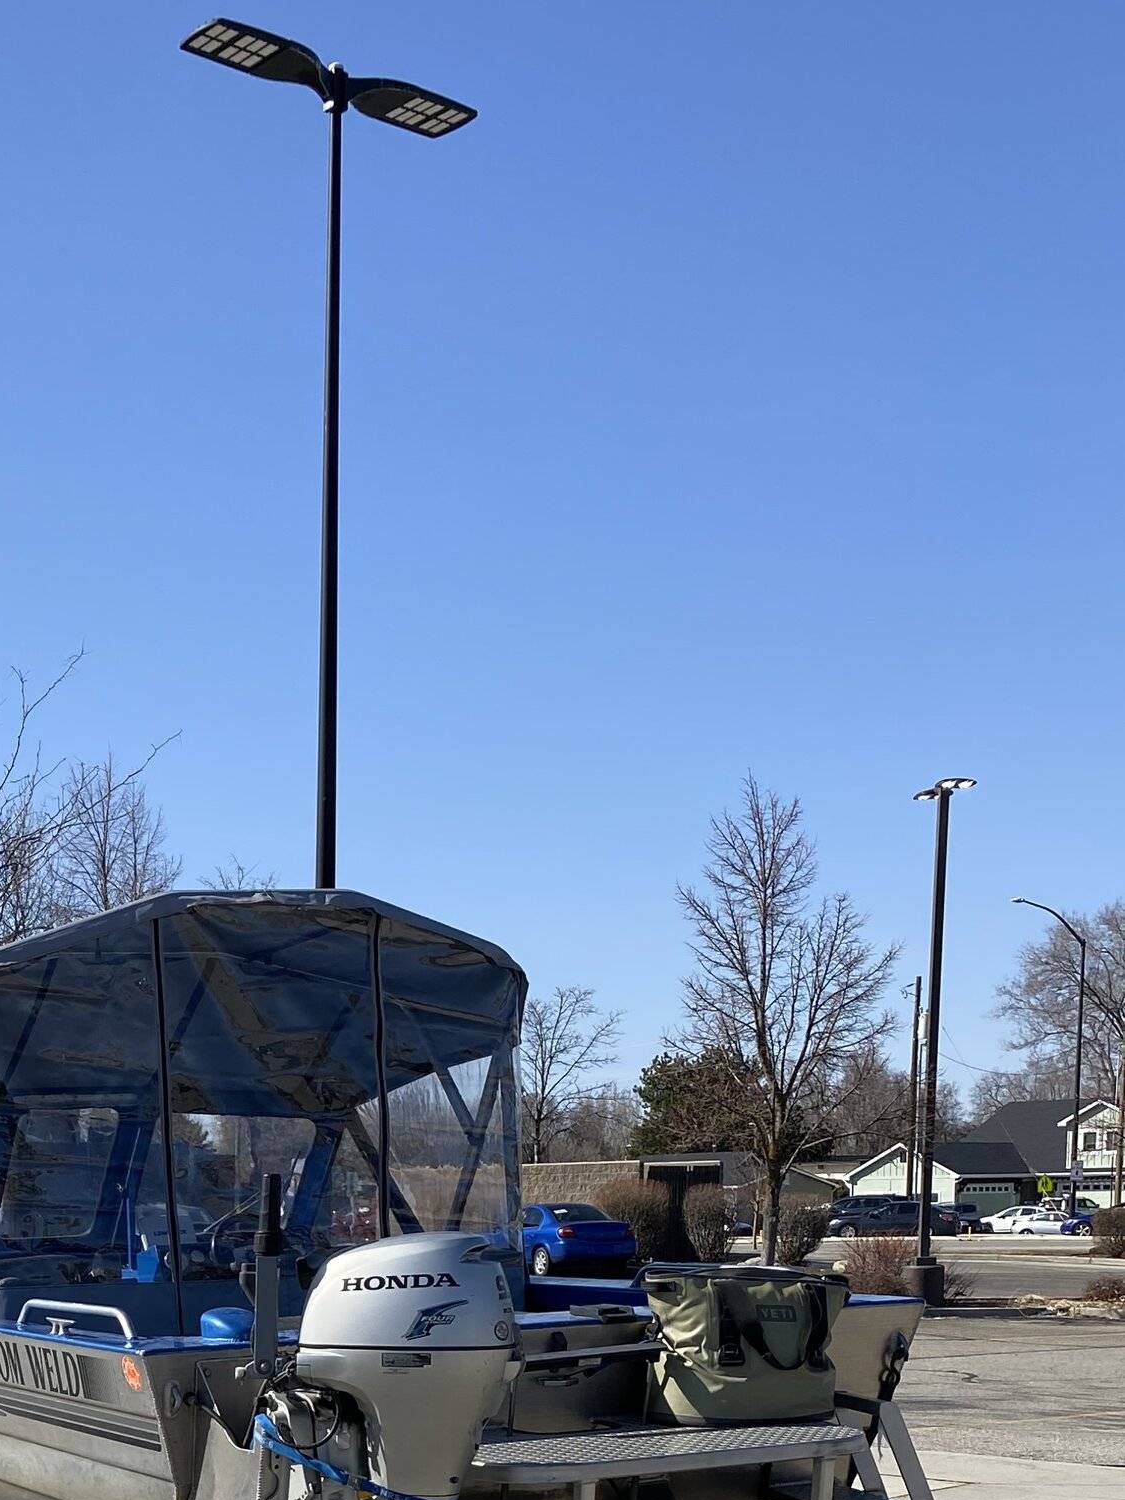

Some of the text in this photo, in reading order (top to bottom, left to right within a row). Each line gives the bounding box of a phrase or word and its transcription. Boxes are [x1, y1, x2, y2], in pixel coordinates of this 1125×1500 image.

[341, 1273, 460, 1291] HONDA
[761, 1307, 794, 1319] YETI
[25, 1344, 80, 1398] WELD
